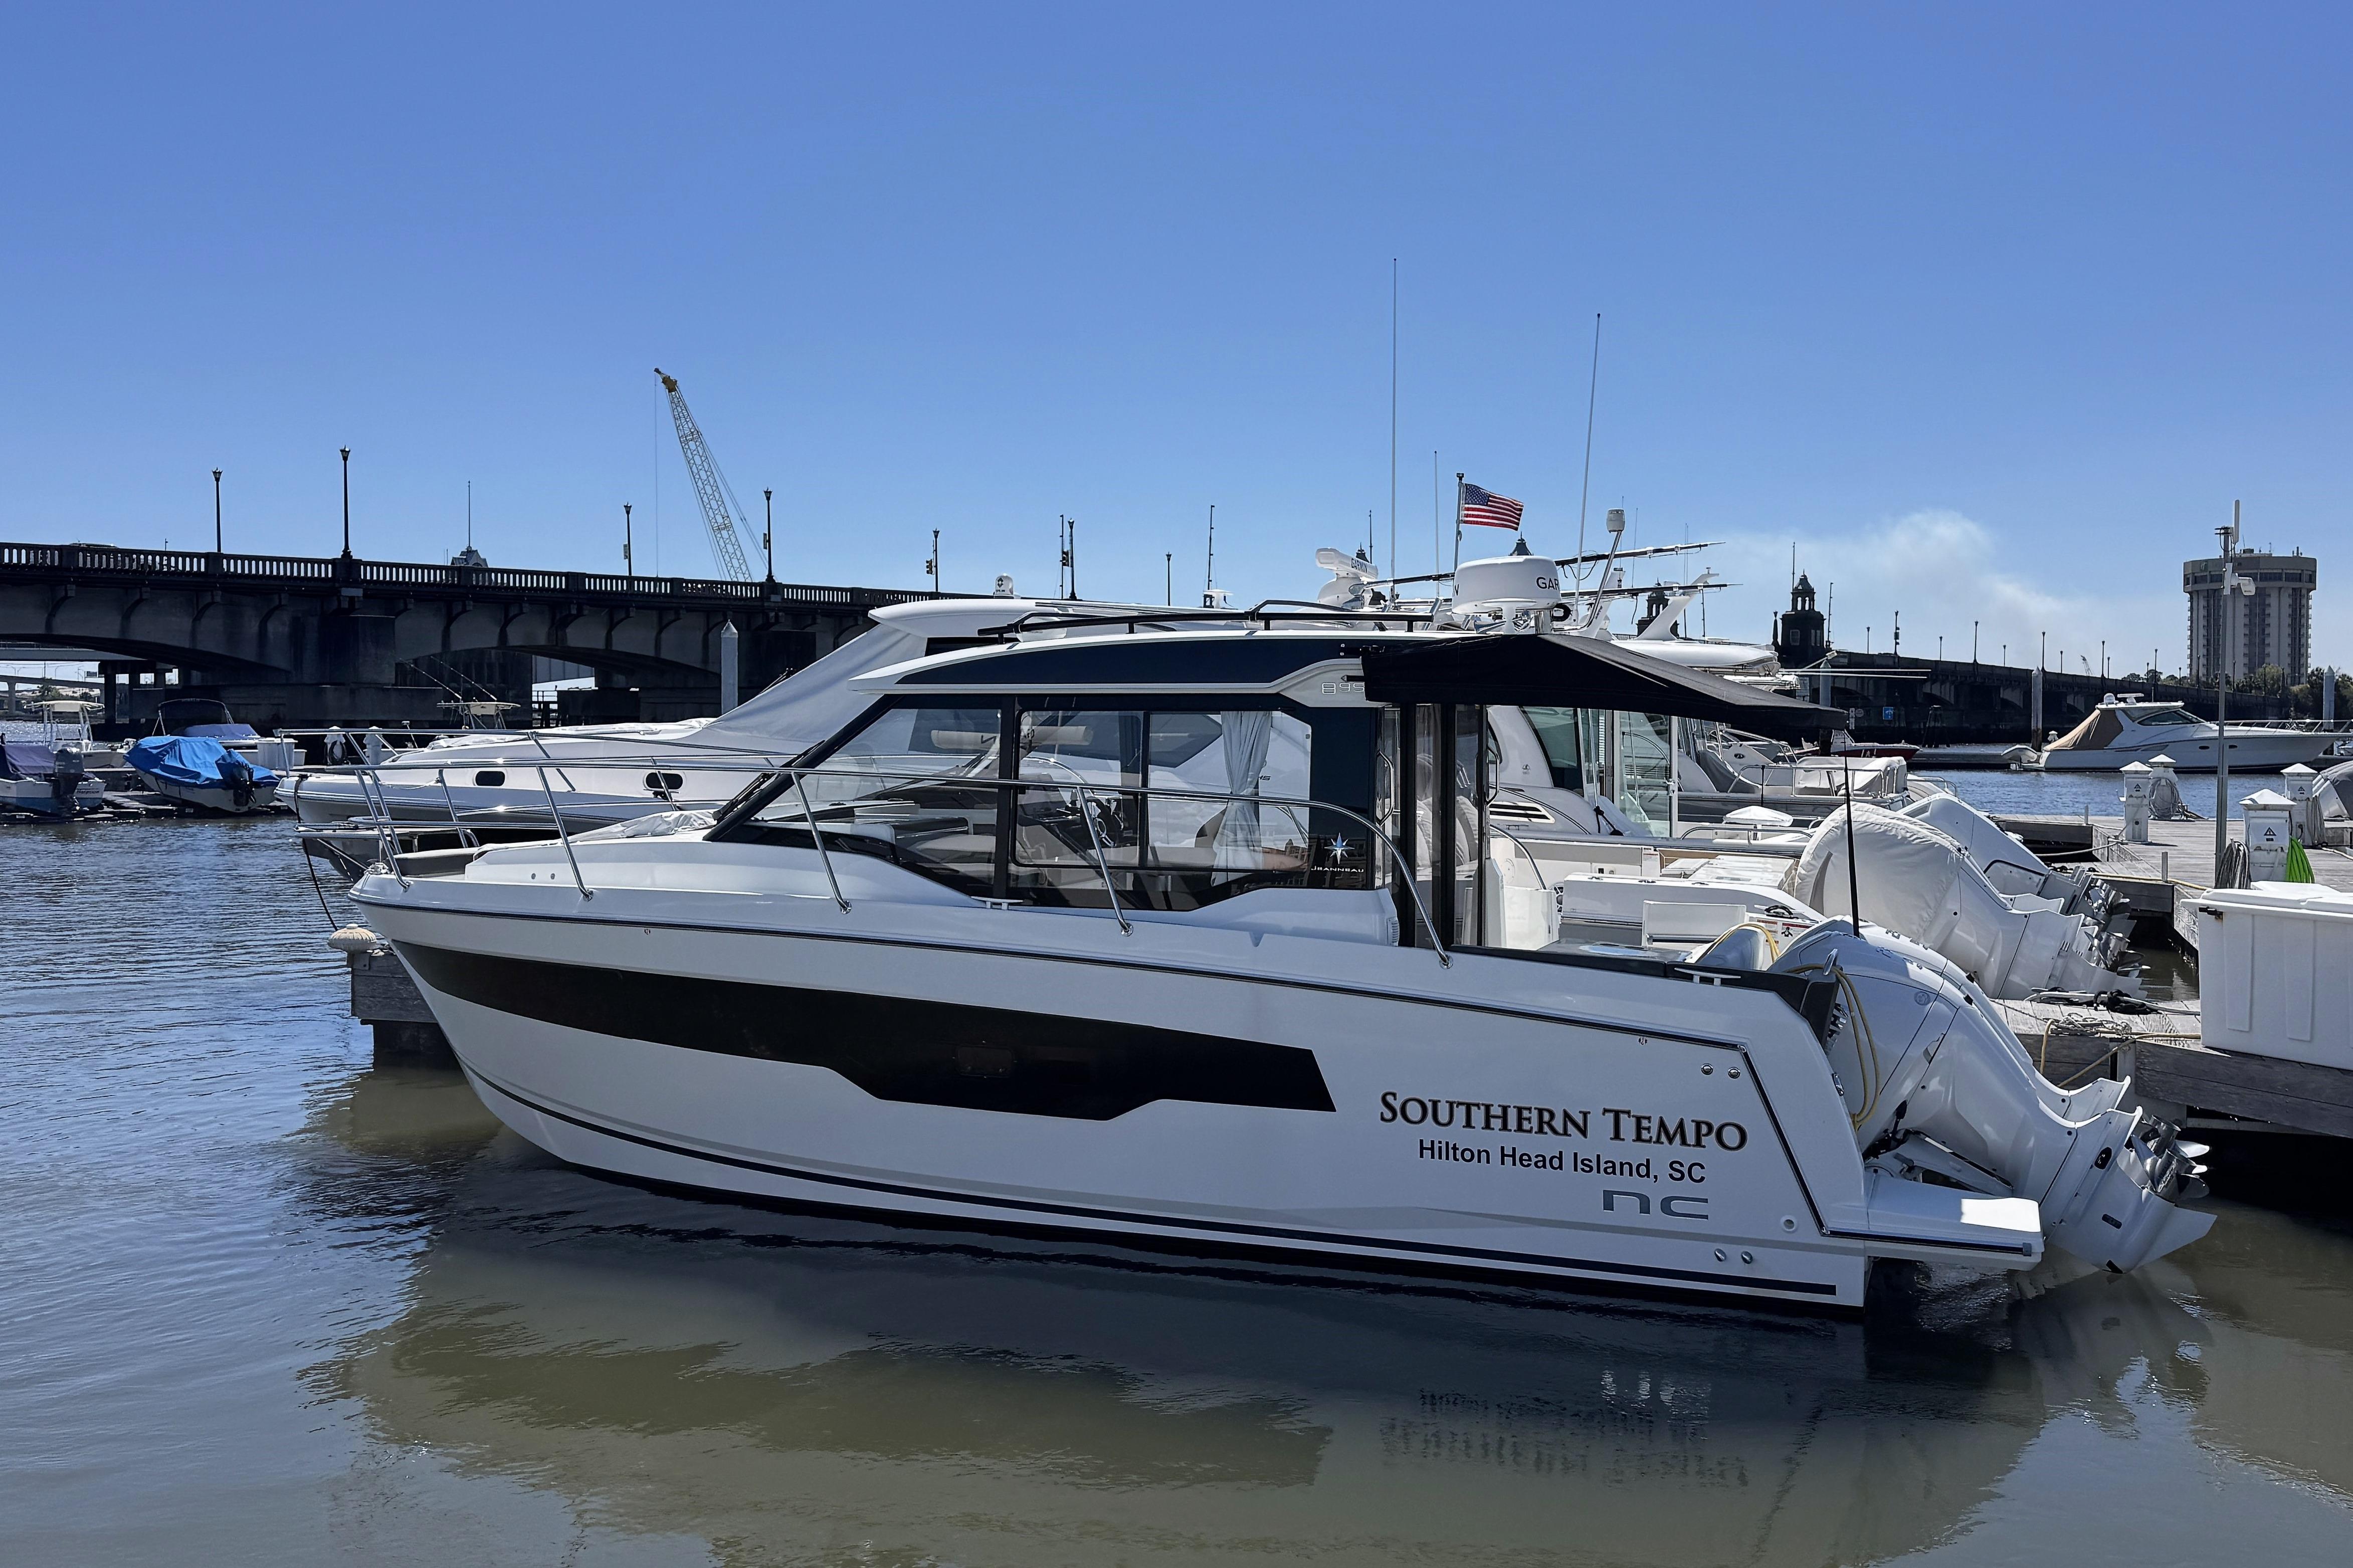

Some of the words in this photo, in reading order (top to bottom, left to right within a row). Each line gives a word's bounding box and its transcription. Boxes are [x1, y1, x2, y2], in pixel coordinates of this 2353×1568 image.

[1322, 683, 1364, 695] 895
[1419, 1139, 1491, 1165] Hilton
[1500, 1146, 1563, 1171] Head
[1573, 1152, 1658, 1183] Island,
[1668, 1160, 1706, 1183] SC
